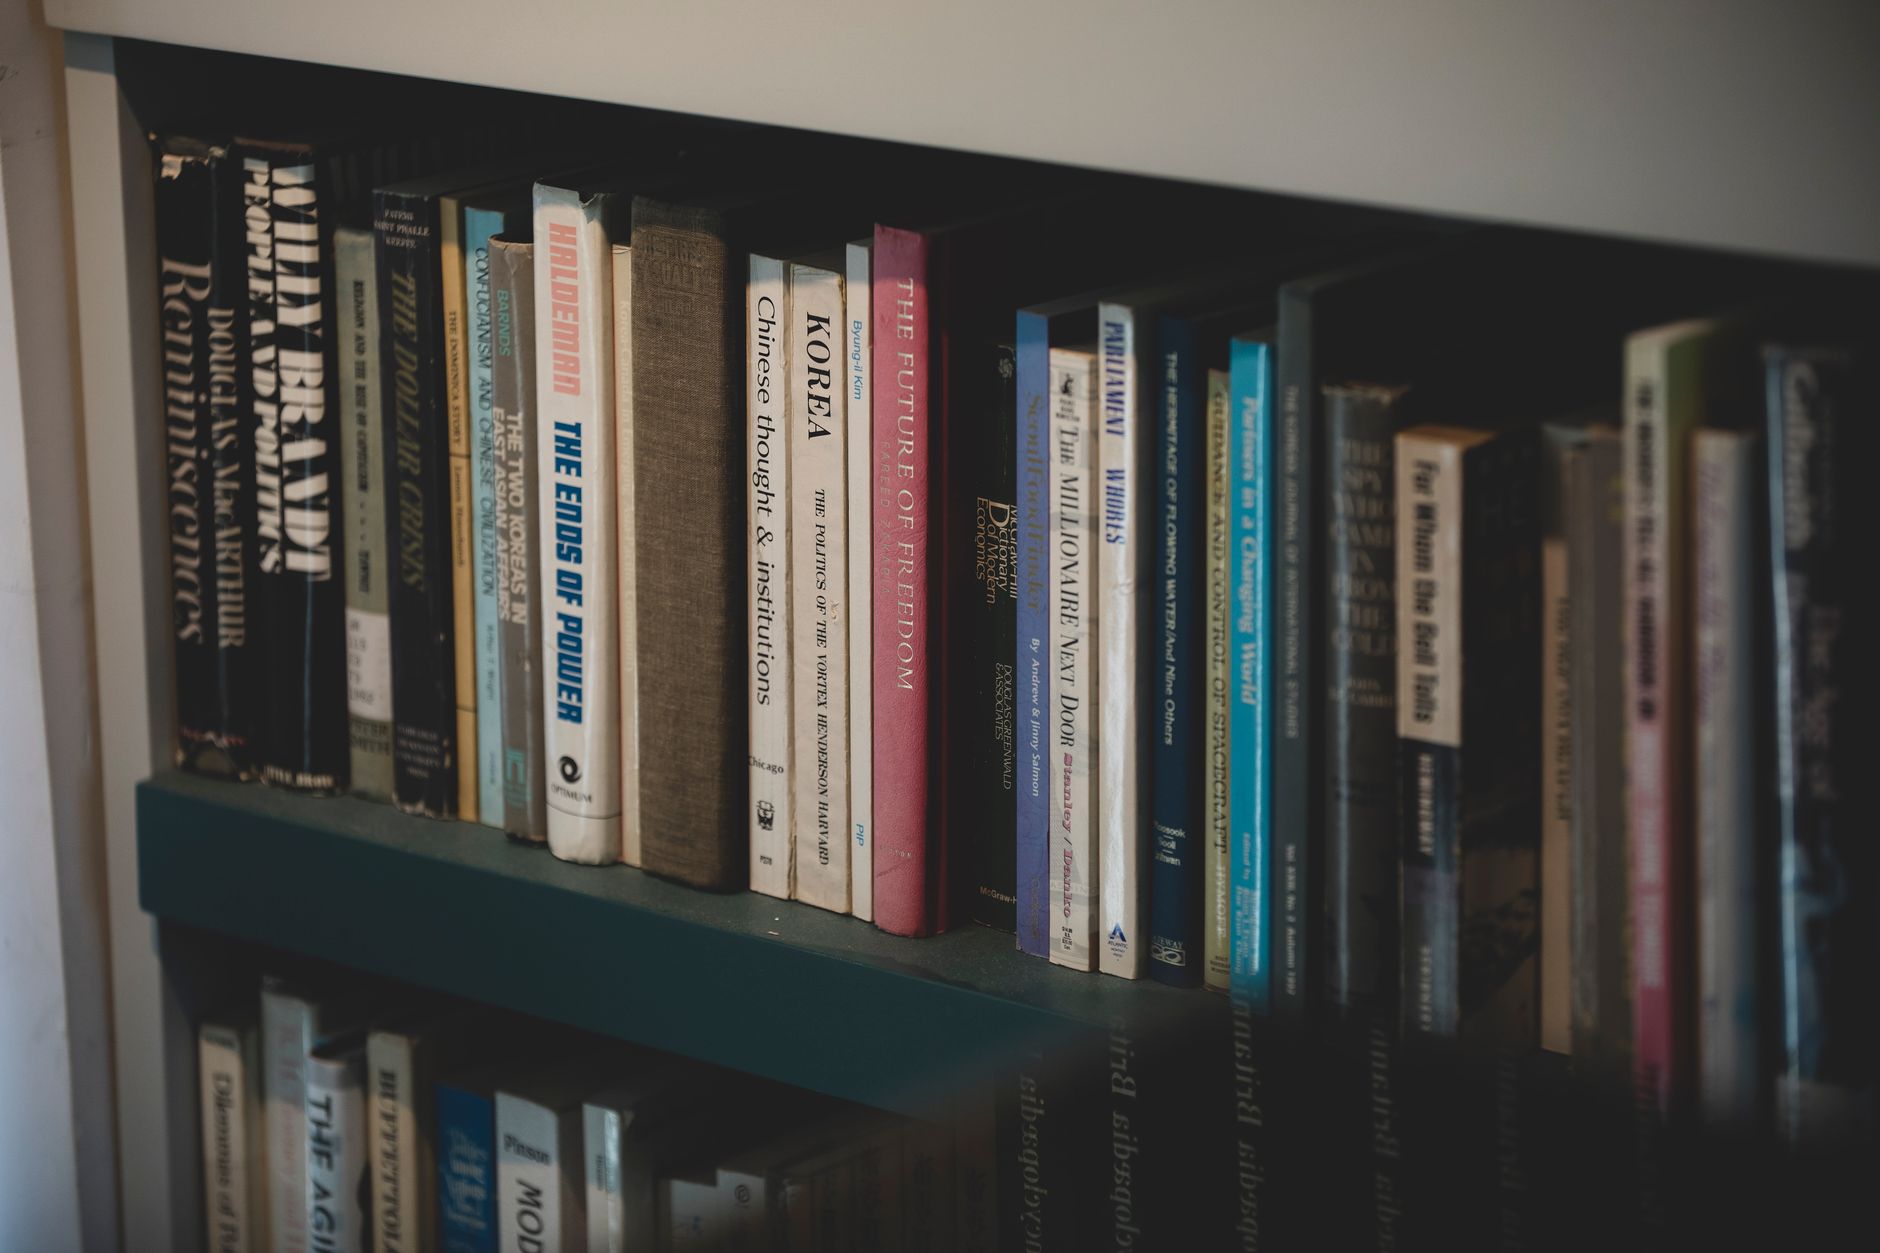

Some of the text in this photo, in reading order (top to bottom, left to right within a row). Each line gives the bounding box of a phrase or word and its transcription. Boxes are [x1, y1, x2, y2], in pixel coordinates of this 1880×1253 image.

[243, 157, 282, 575] PEOPLE AND POLITICS
[272, 163, 332, 582] WILLY BRANDT
[391, 268, 418, 341] THE
[496, 288, 511, 357] BARNDS
[549, 222, 581, 397] HALDEMAN
[806, 312, 832, 440] KOREA
[851, 320, 864, 400] Byung-il Kim
[160, 257, 212, 645] Reminiscences
[207, 307, 245, 649] DOUGLAS MacARTHUR
[392, 342, 421, 476] DOLLAR
[474, 247, 495, 597] CONFUCIANISM AND CHINESE CIVILIZATION
[896, 277, 915, 691] THE FUTURE OF FREEDOM
[1060, 426, 1079, 465] THE
[1105, 322, 1126, 546] PARLIAMENT WHORES
[492, 406, 510, 621] EAST ASIAN AFFAIRS
[507, 411, 528, 625] THE TWO KOREAS IN
[554, 421, 582, 725] THE ENDS OF POWER
[752, 296, 776, 706] Chinese thought & institutions
[880, 441, 891, 594] FAREED ZAKARIA
[976, 497, 989, 580] Economics
[987, 523, 999, 604] of Modern
[988, 500, 1011, 592] Dictionary
[1060, 473, 1079, 626] MILLIONAIRE
[1164, 352, 1178, 745] THE HERMITAGE OF FLOWING WATER/And Nine Others
[1238, 394, 1257, 706] Partners in a Changing World
[814, 488, 830, 866] THE POLITICS OF THE VORTEX HENDERSON HARVARD
[1061, 634, 1079, 687] NEXT
[1213, 391, 1227, 854] GUIDANCE AND CONTROL OF SPACECRAFT
[749, 755, 784, 775] Chicago
[995, 671, 1004, 740] ASSOCIATES
[1003, 664, 1013, 790] DOUGLAS GREENWALD
[1029, 638, 1041, 796] By Andrew & Jinny Salmon
[1061, 694, 1080, 747] DOOR
[856, 823, 865, 847] PIP
[1062, 752, 1074, 832] Stanley
[1063, 849, 1074, 918] Danko
